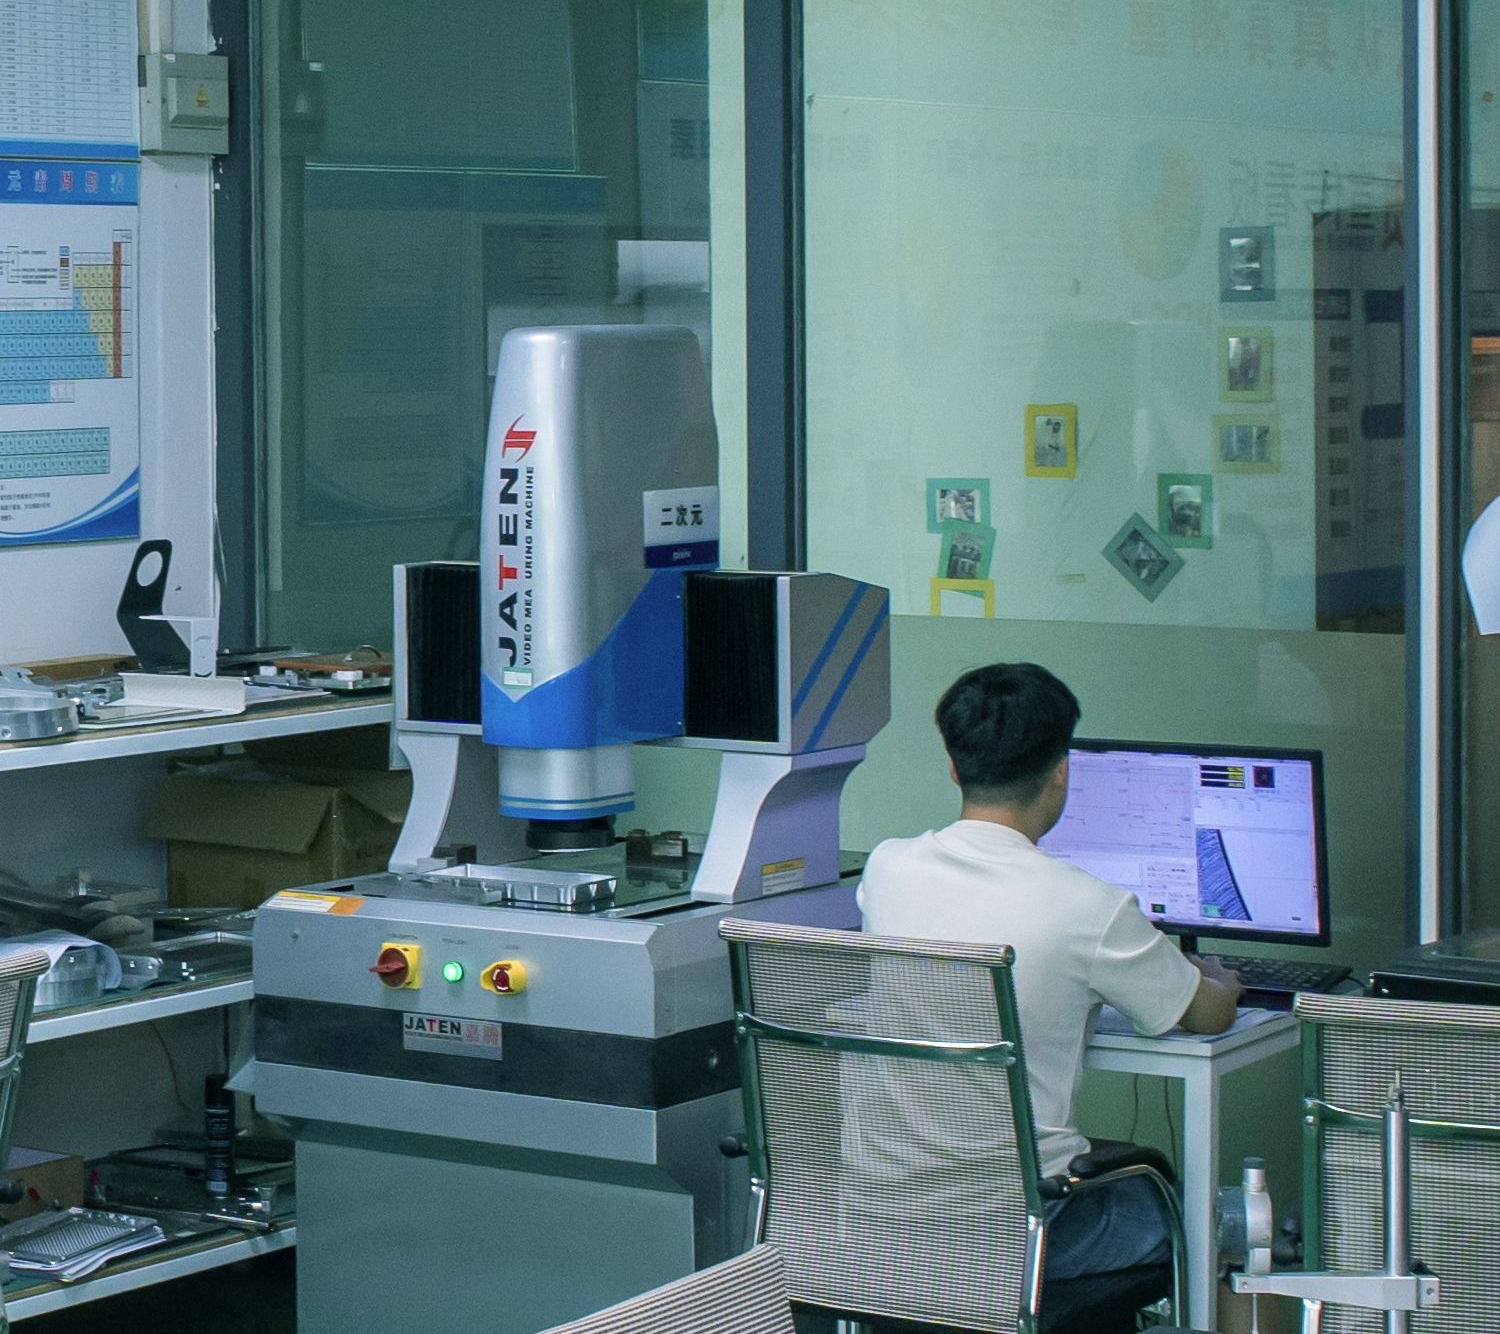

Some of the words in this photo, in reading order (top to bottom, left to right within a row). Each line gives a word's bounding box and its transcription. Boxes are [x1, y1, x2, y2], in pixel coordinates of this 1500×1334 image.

[524, 466, 534, 531] MACHINE
[660, 503, 704, 527] 二次元
[497, 467, 519, 668] JATEN
[404, 1016, 462, 1036] JATEN
